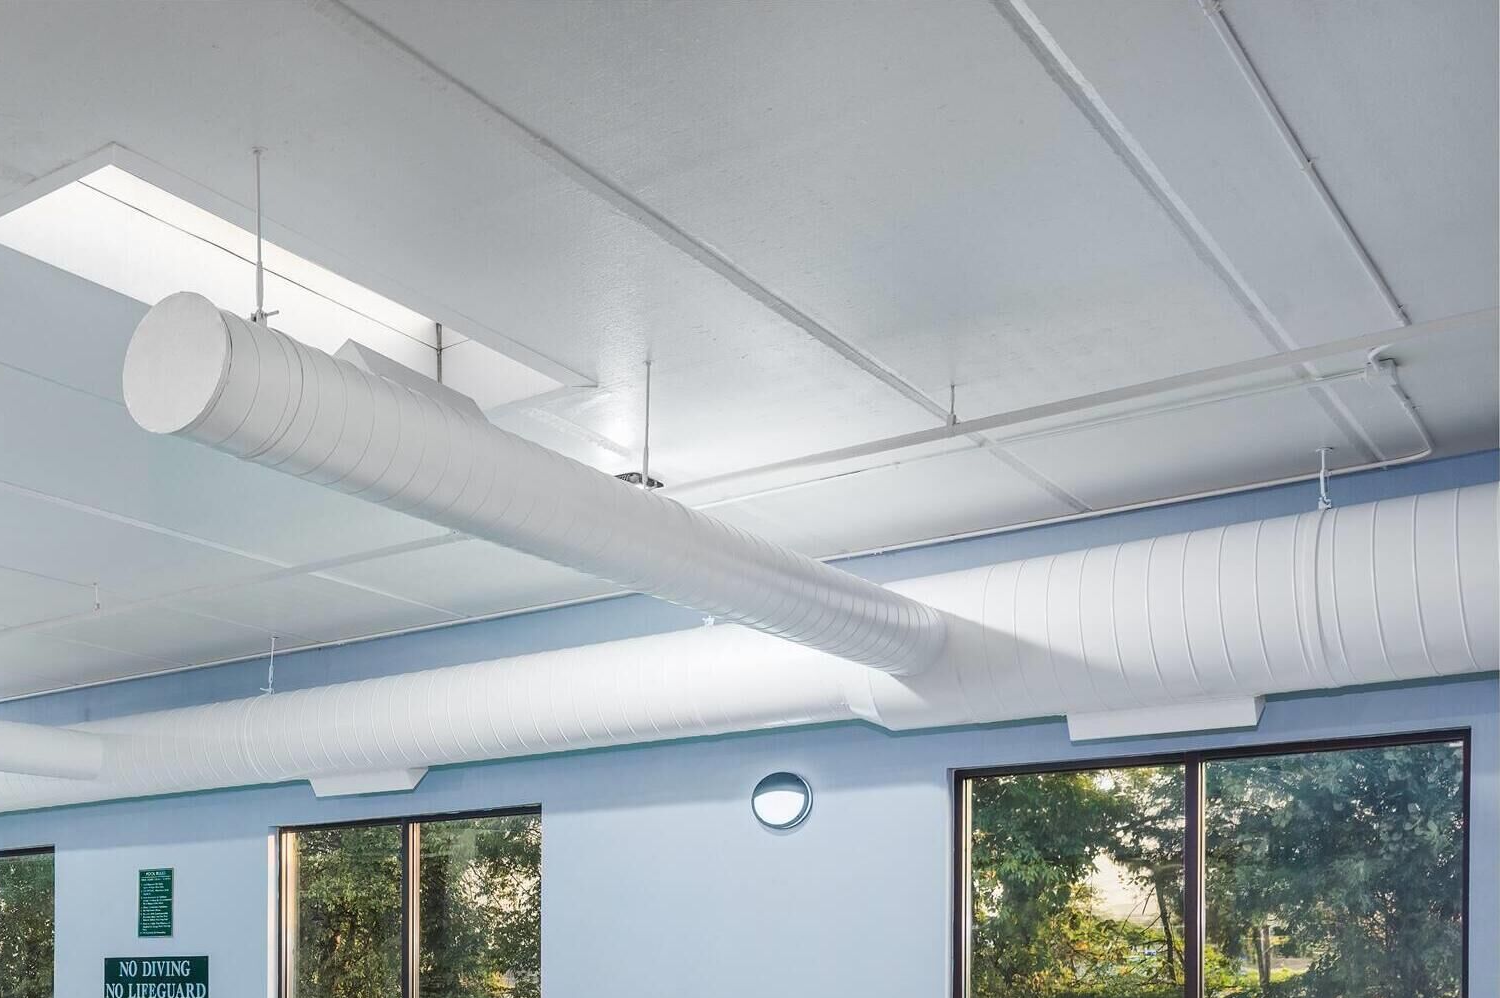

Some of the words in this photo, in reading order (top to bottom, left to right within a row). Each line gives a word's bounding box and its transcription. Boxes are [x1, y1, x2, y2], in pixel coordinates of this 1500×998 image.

[119, 960, 137, 977] NO
[142, 959, 191, 977] DIVING
[105, 983, 123, 998] NO
[128, 983, 207, 998] LIFEGUARD
